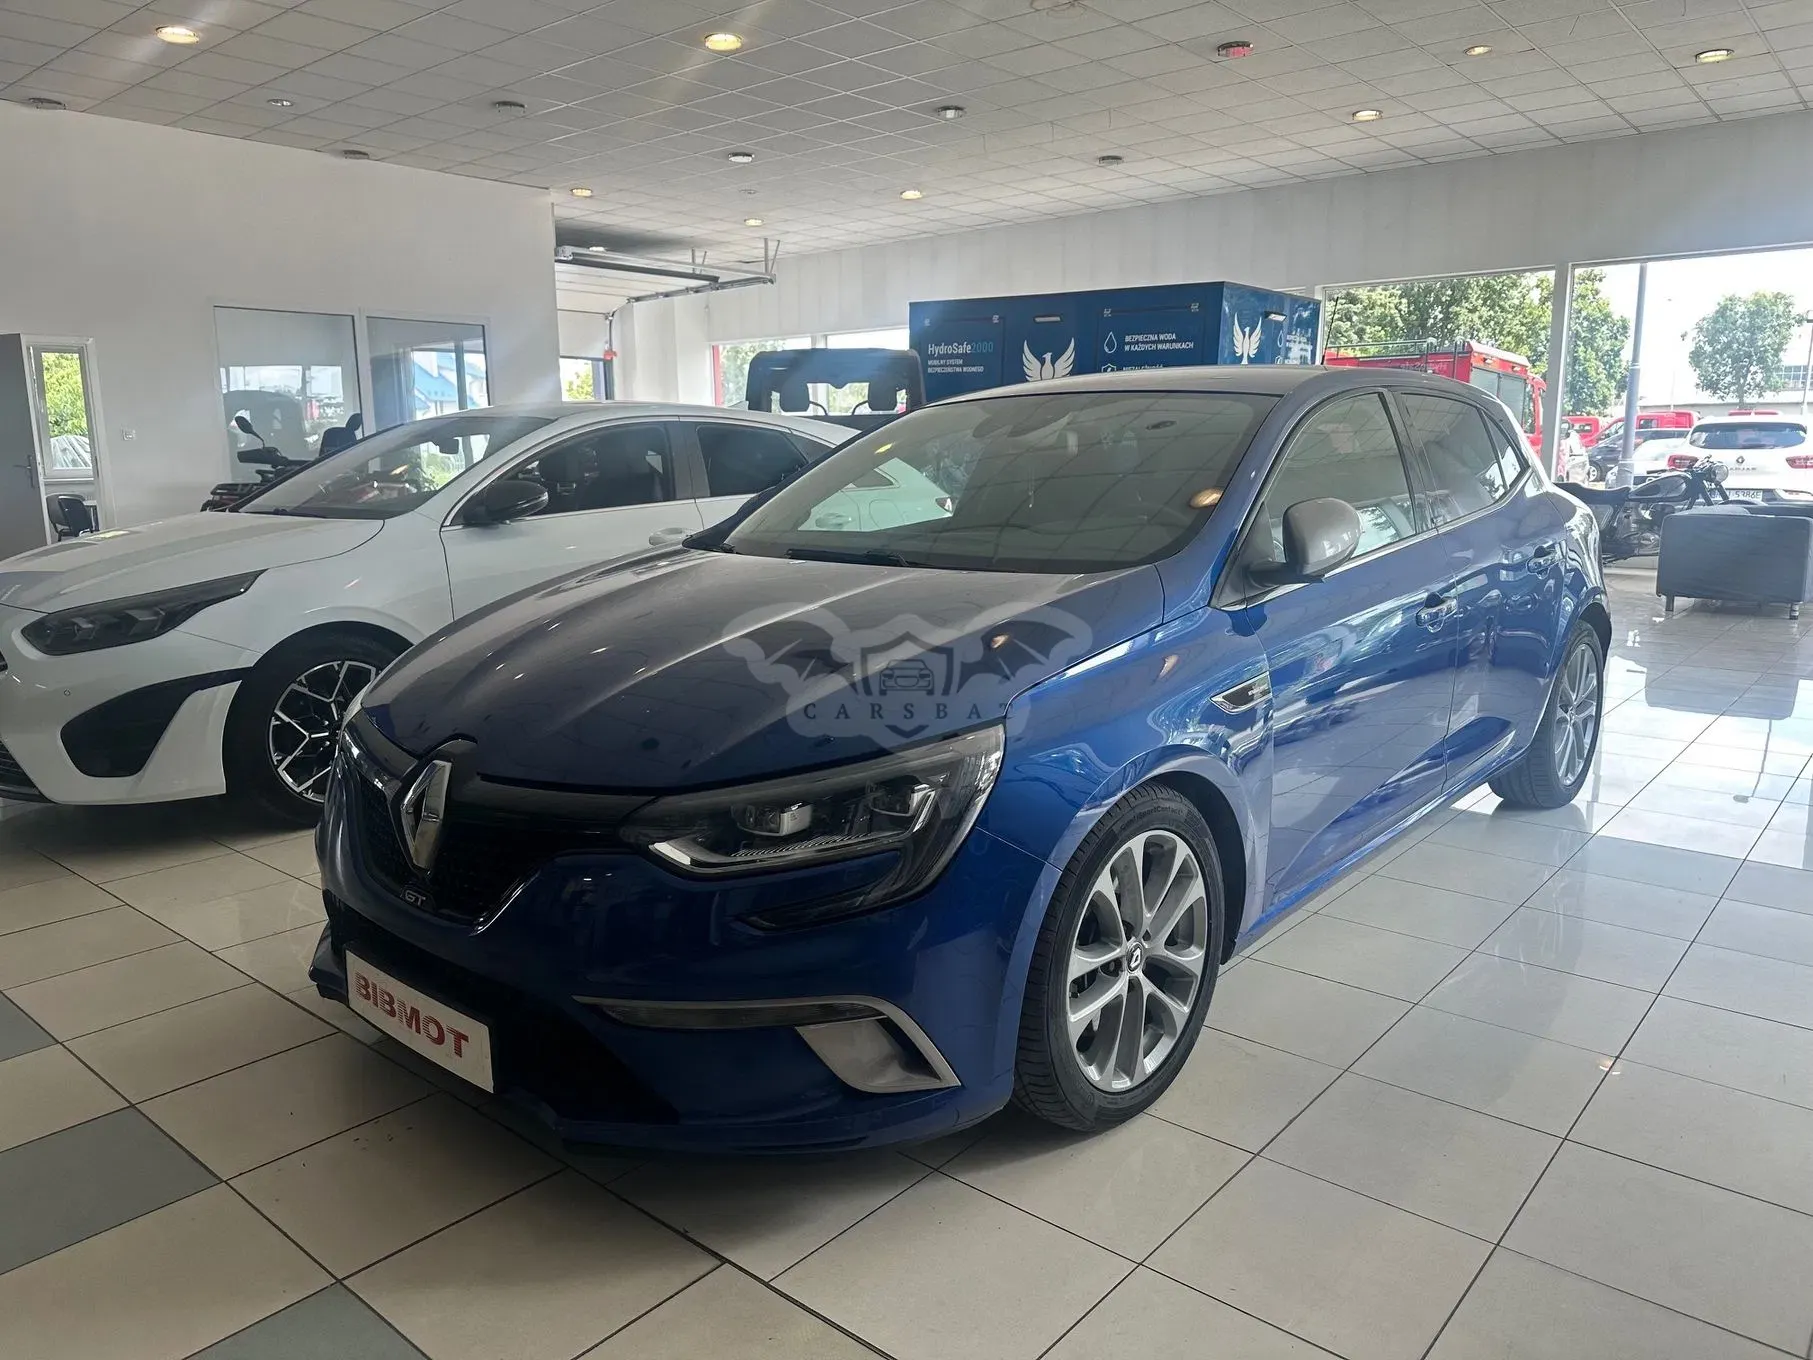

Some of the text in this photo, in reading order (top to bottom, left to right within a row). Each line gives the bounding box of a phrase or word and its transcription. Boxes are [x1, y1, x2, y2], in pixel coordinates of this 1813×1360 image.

[1125, 333, 1176, 342] BEZPIECZNA WODA
[1157, 341, 1194, 350] WARUNKACH
[928, 341, 994, 357] HydroSafe2000
[405, 890, 426, 906] GT
[355, 972, 469, 1058] BIBMOT
